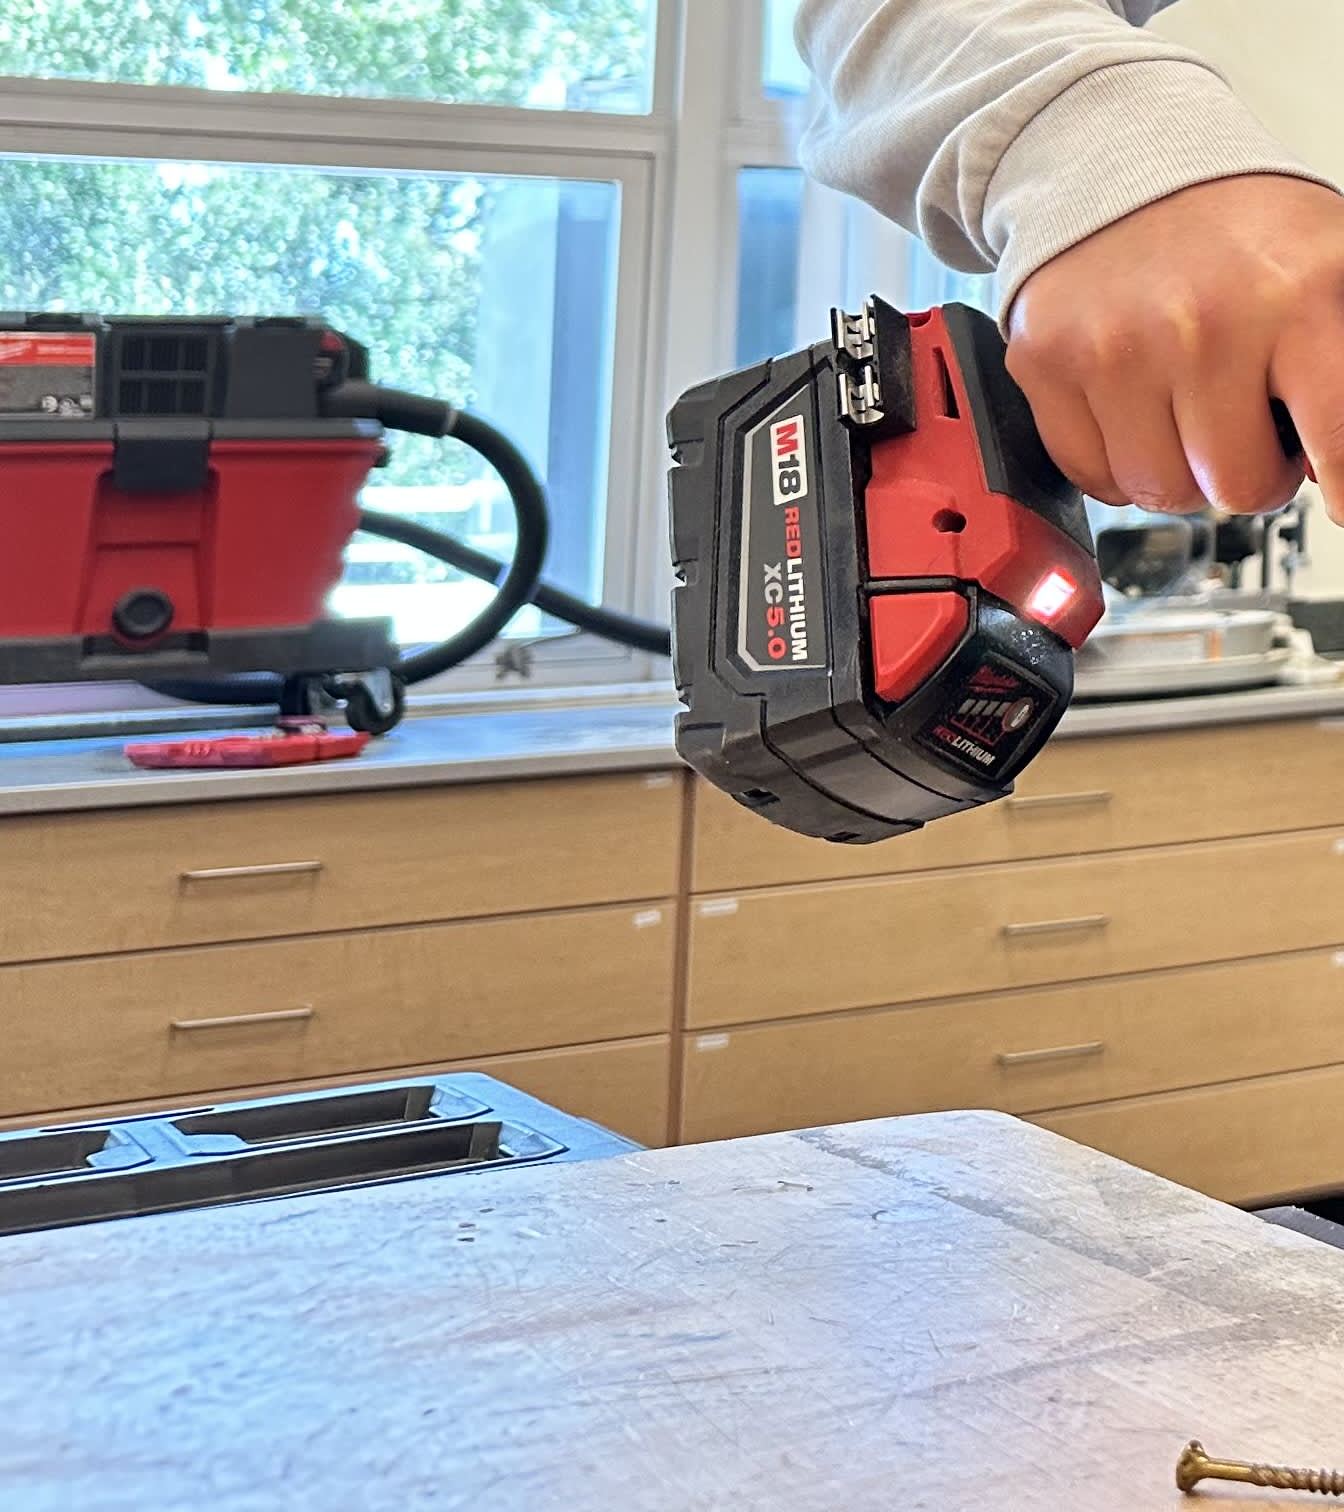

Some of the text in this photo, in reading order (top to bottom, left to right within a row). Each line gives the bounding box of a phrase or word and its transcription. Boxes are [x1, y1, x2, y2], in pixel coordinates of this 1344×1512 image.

[763, 561, 788, 661] XC5.0
[775, 420, 809, 661] M18 REDLITHIUM
